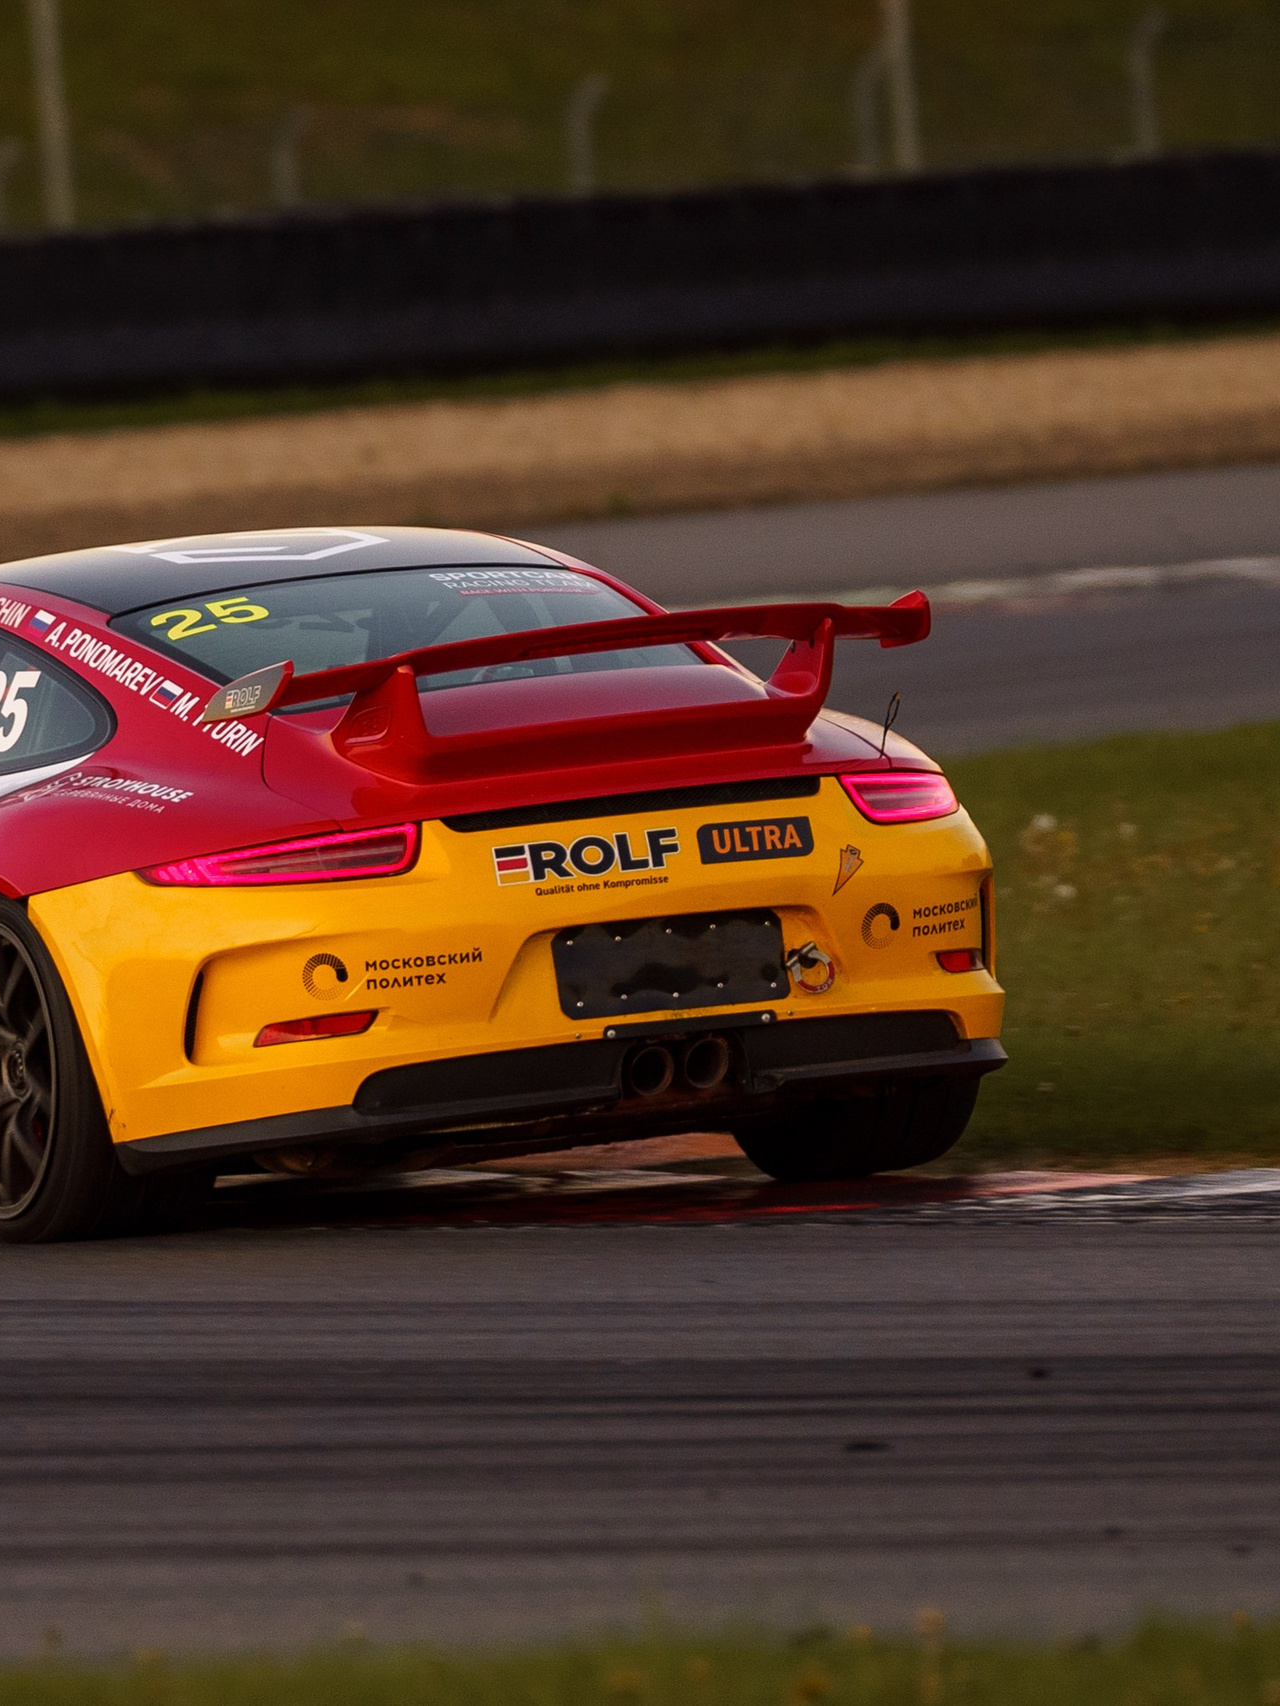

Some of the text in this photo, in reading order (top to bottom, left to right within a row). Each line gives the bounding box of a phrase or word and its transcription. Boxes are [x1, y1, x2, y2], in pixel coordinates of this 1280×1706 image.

[429, 571, 583, 582] SPORTCAR
[443, 579, 597, 589] RACING TEAM
[150, 596, 269, 641] 25
[232, 685, 261, 707] ROLF
[170, 692, 264, 757] M. URIN
[72, 776, 194, 803] STROYHOUSE
[712, 824, 802, 854] ULTRA
[528, 827, 680, 881] ROLF
[535, 875, 669, 896] Qualität ohne Kompromisse
